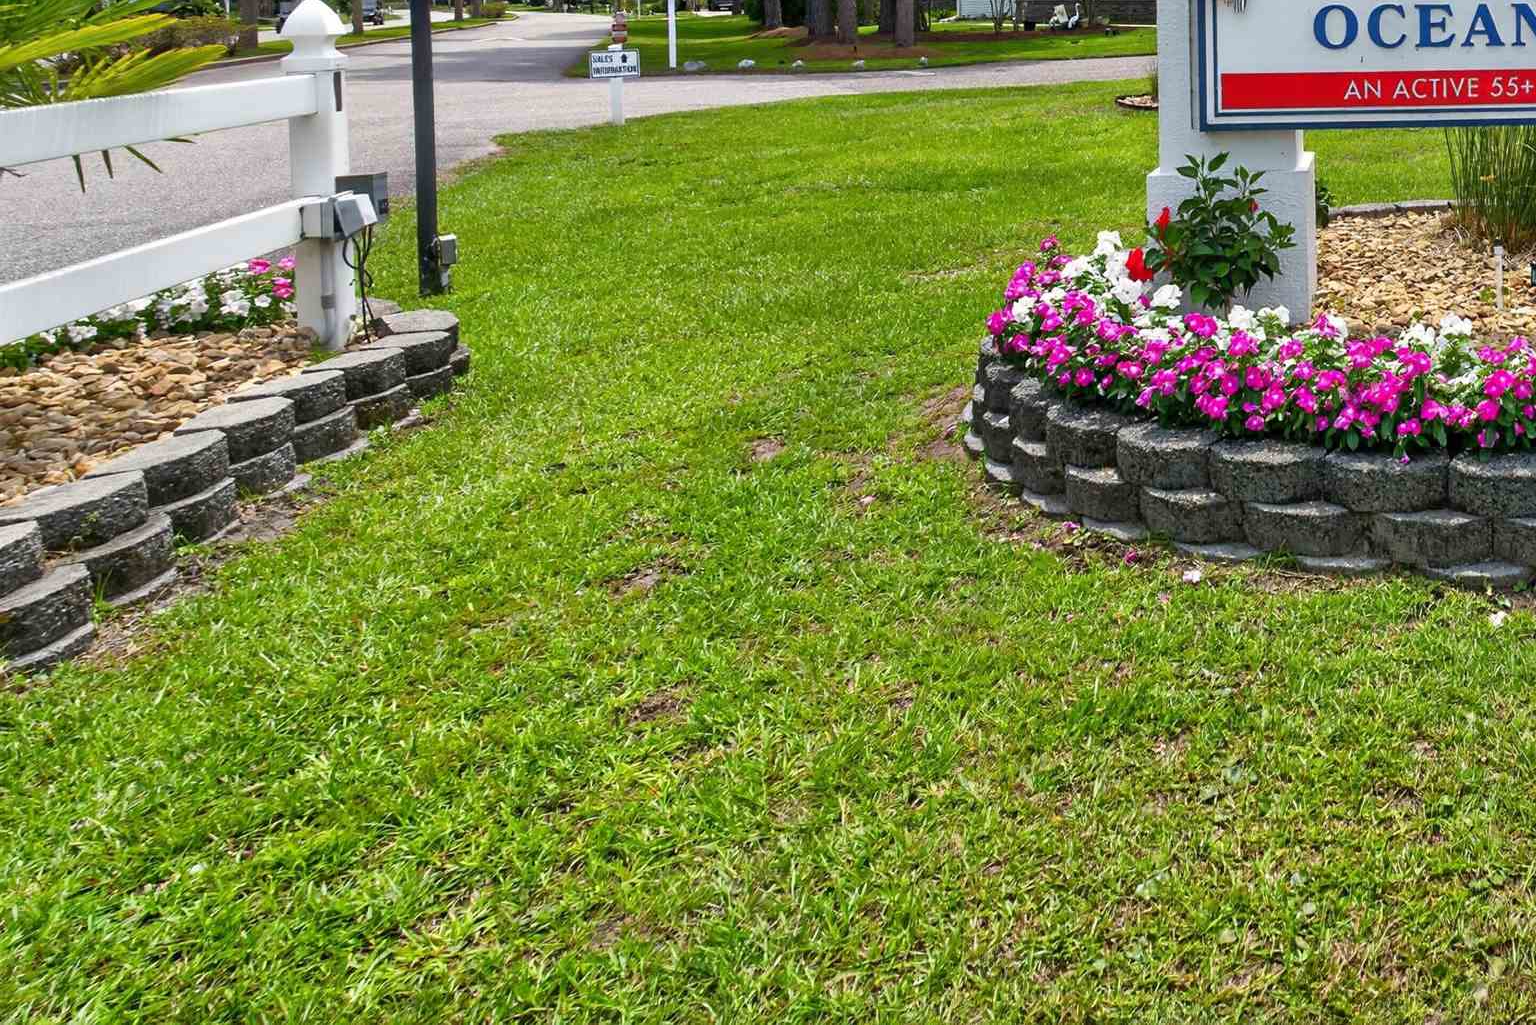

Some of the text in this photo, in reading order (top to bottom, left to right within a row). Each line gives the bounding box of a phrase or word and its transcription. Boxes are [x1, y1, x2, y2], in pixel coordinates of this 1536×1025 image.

[1343, 80, 1382, 100] AN
[1392, 77, 1480, 99] ACTIVE
[1490, 76, 1534, 98] 55+
